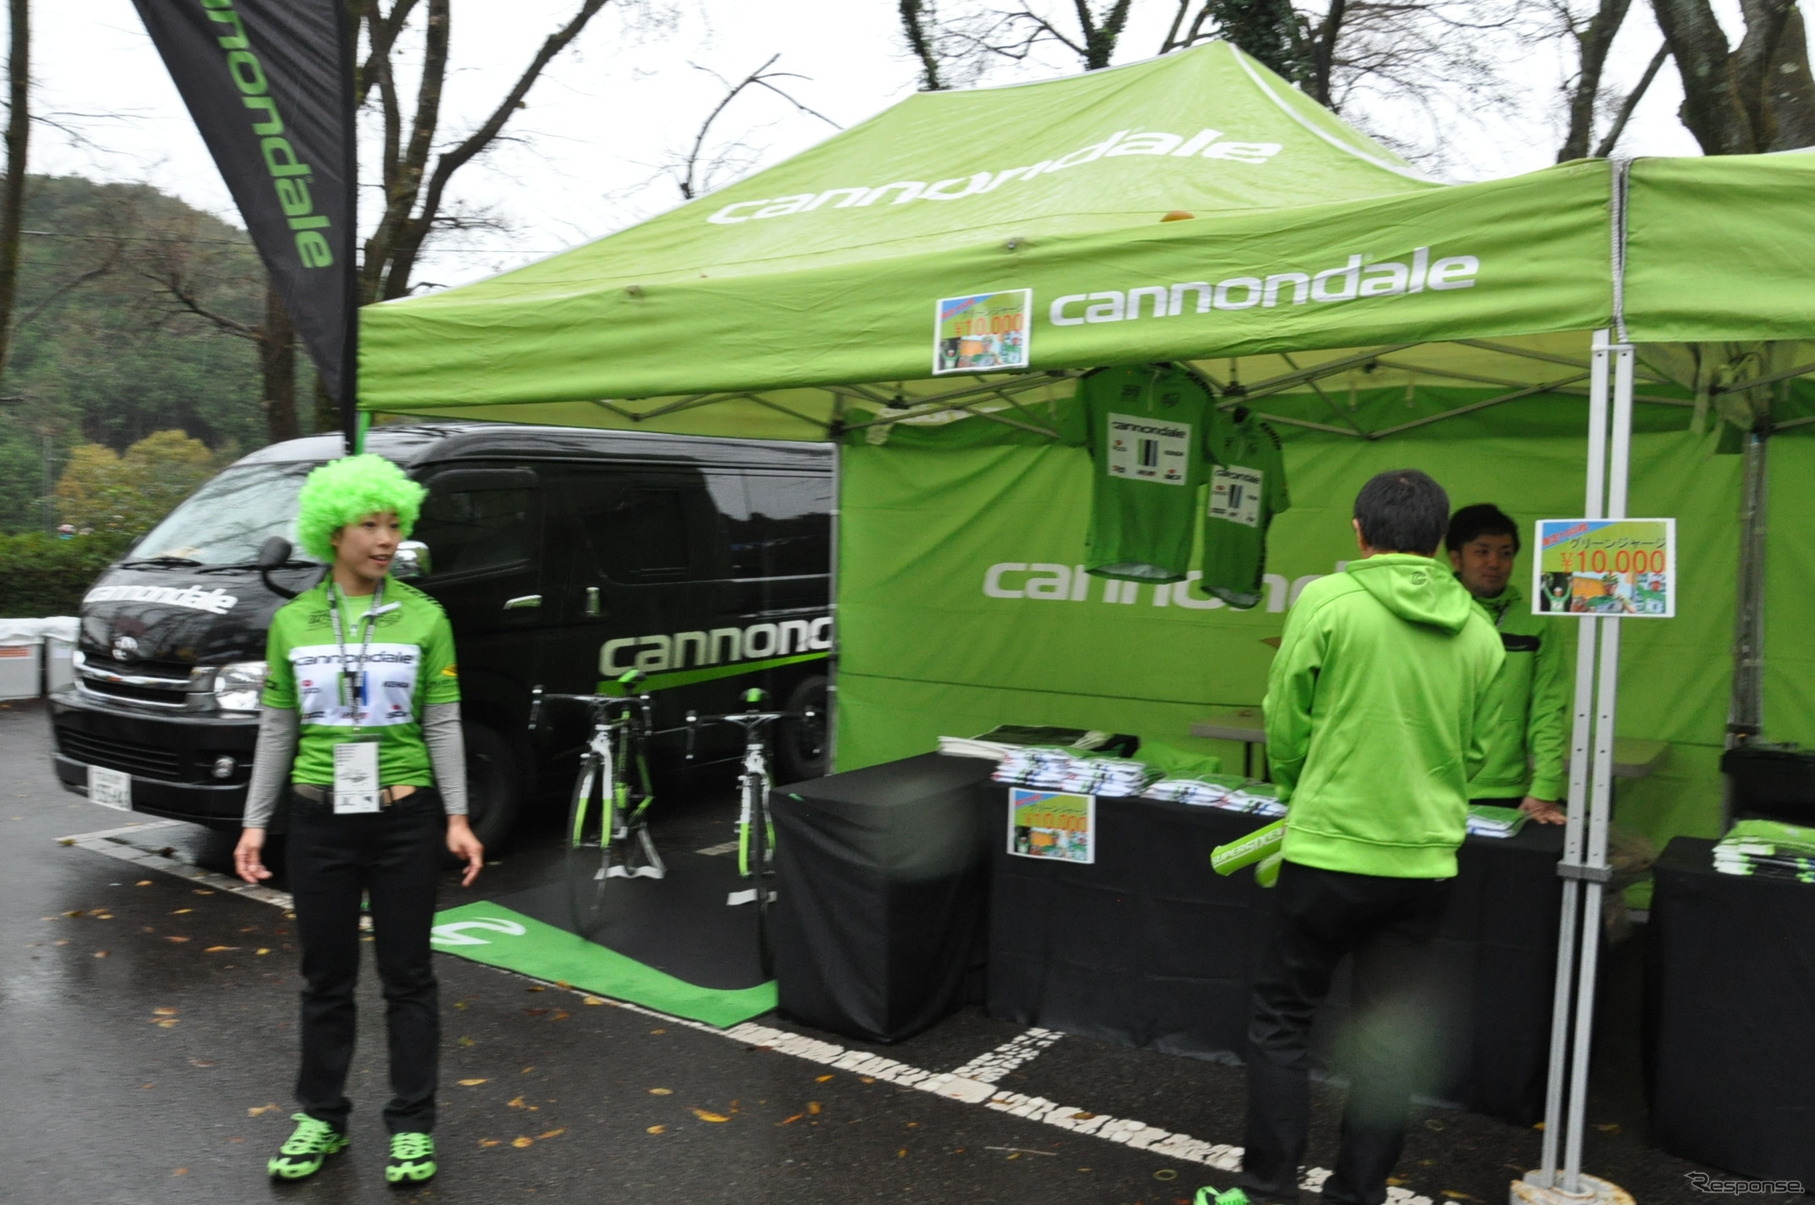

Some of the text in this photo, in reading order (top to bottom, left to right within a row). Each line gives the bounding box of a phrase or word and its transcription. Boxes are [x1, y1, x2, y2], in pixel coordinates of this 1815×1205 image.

[202, 0, 334, 269] nondale
[706, 128, 1283, 225] cannondale
[1048, 246, 1480, 327] cannondale
[1561, 549, 1666, 576] ¥10,000
